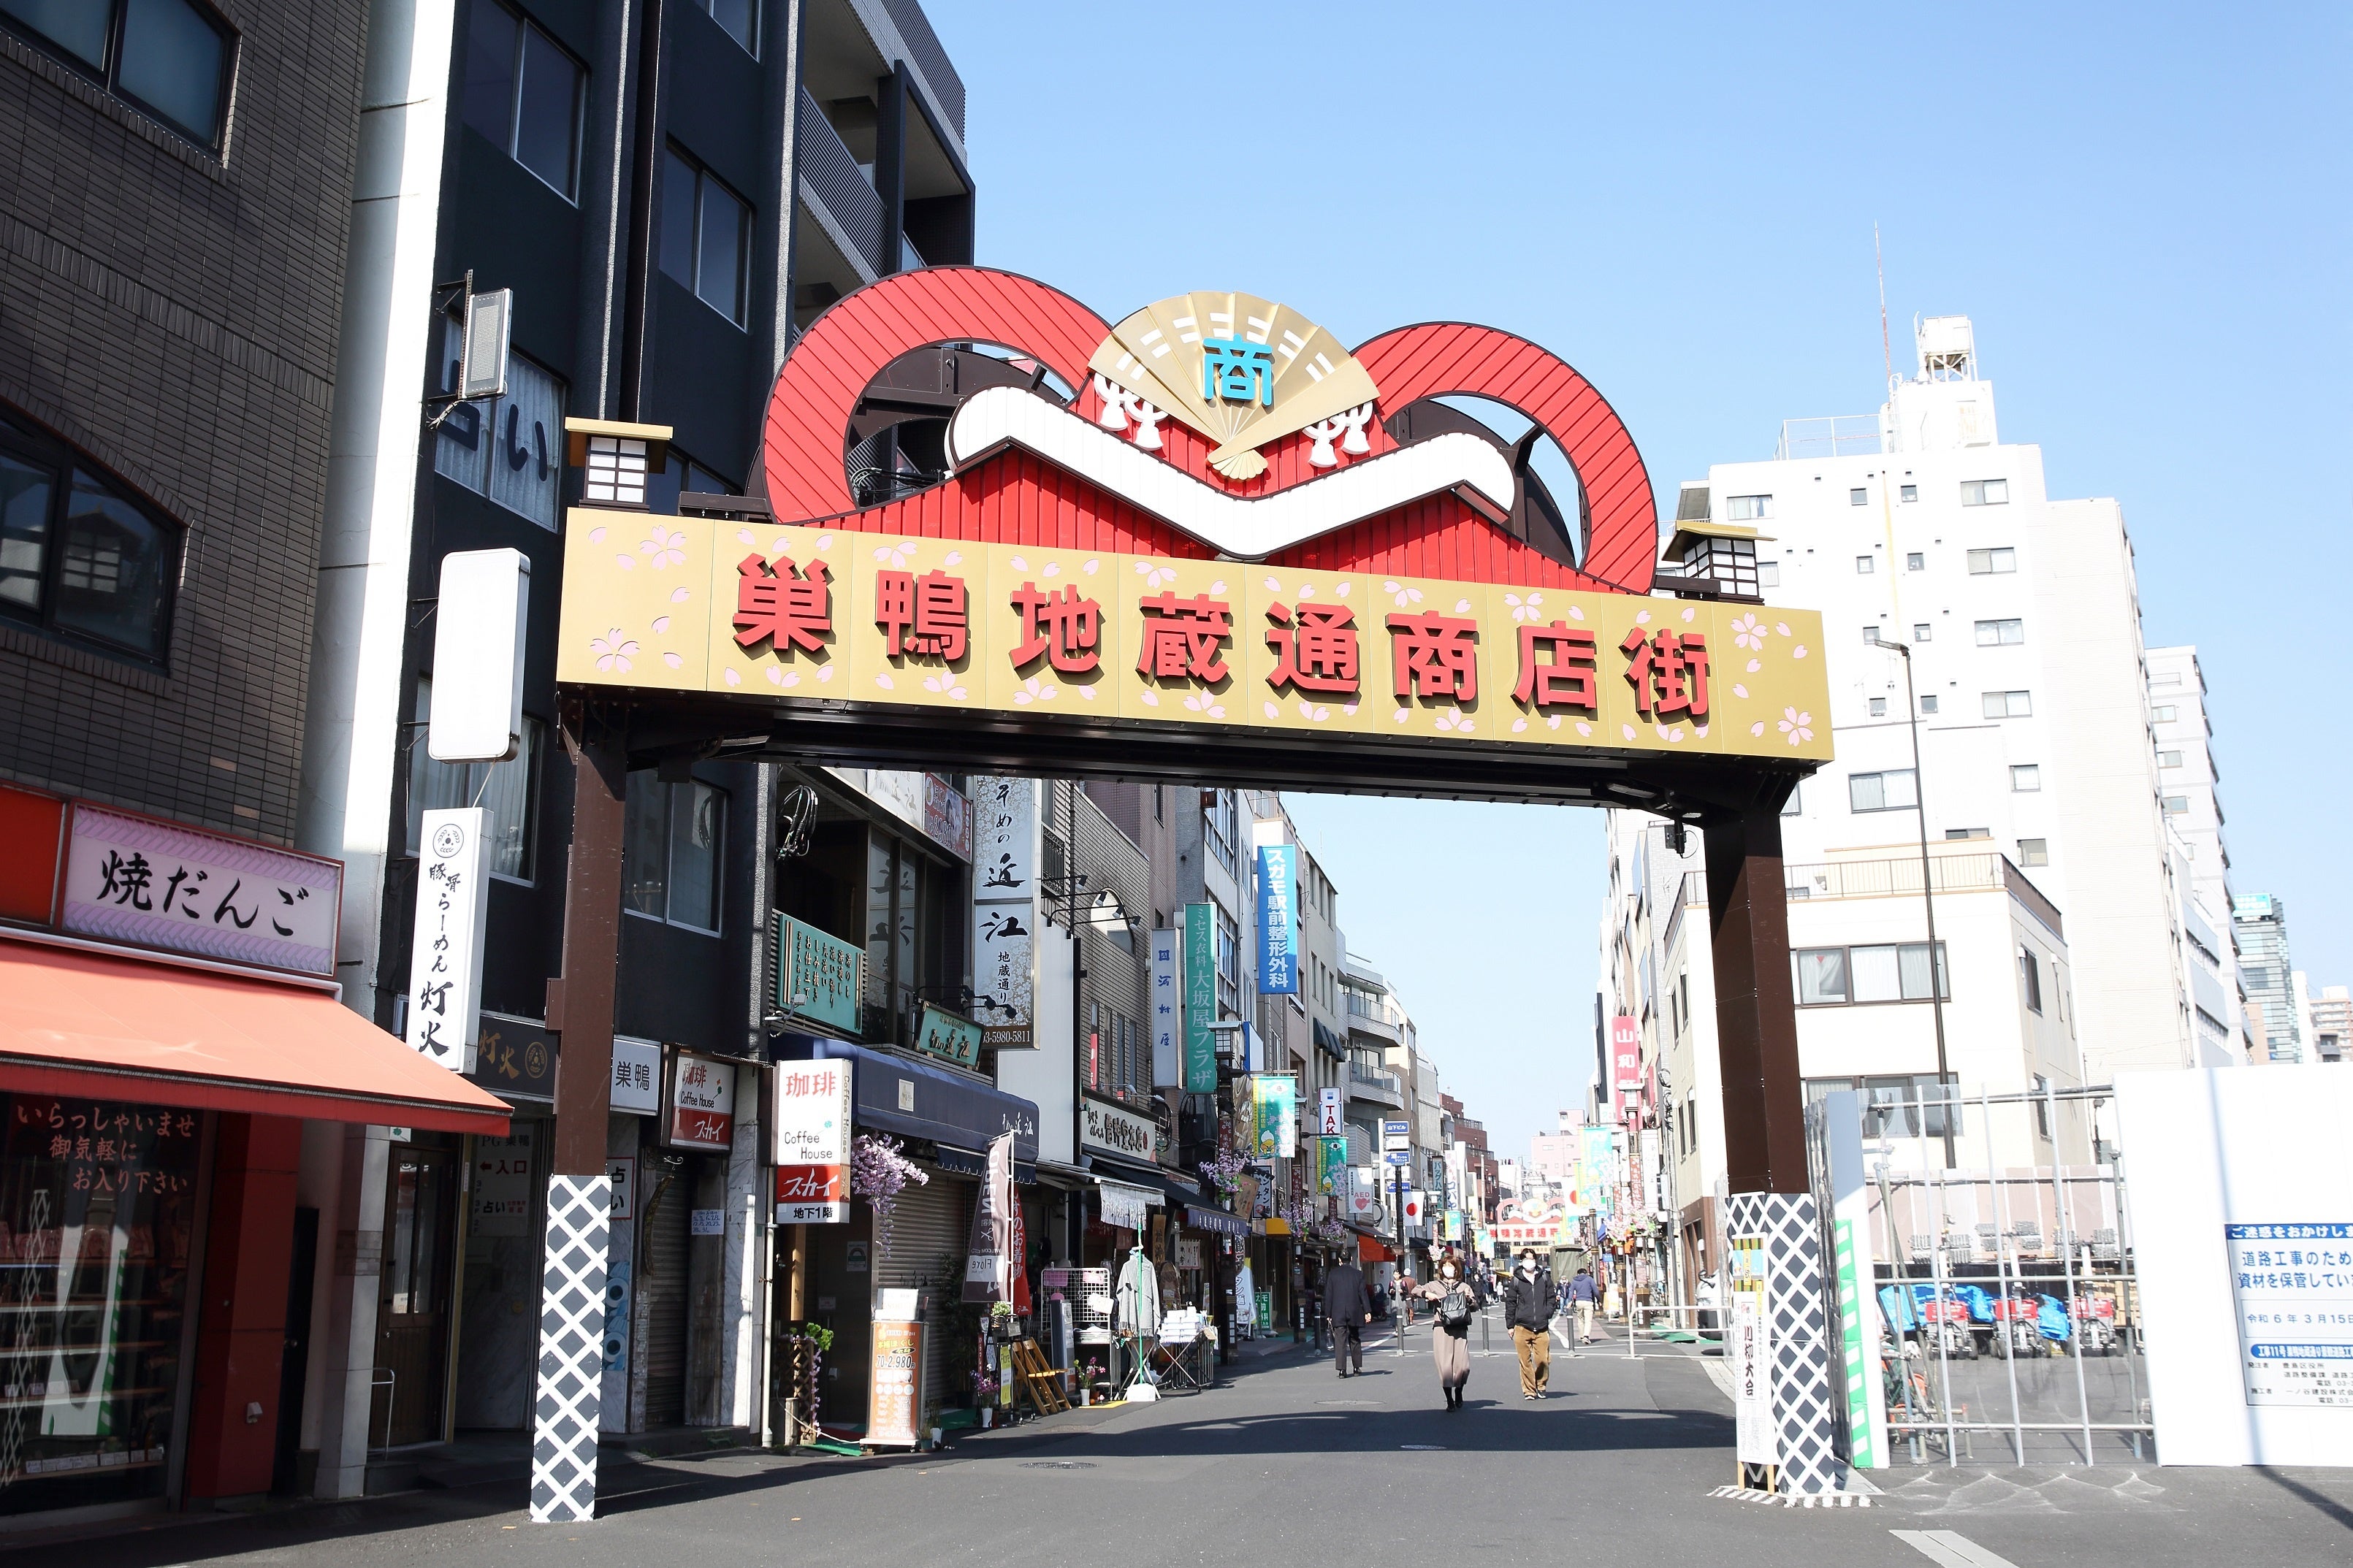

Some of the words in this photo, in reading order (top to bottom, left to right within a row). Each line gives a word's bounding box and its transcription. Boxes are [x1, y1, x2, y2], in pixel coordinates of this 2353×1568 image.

[1202, 334, 1273, 407] 商
[732, 553, 1712, 718] 巣鴨地蔵通商店街
[97, 849, 310, 937] 焼だんご
[1267, 849, 1289, 989] スガモ駅前整形外科
[1194, 907, 1208, 968] ミセス衣料
[997, 951, 1011, 1004] 地蔵通り
[419, 981, 454, 1056] 灯火
[1192, 969, 1213, 1089] 大坂屋プラザ
[478, 1028, 521, 1081] 灯火
[616, 1060, 650, 1091] 巣鴨
[682, 1063, 707, 1088] 珈琲
[785, 1071, 837, 1098] 珈琲
[680, 1090, 698, 1106] Coffee
[698, 1095, 715, 1109] House
[17, 1103, 196, 1138] いらっしゃいませ
[694, 1114, 724, 1141] スカイ
[50, 1135, 138, 1161] 御気軽に
[784, 1131, 820, 1144] Coffee
[842, 1118, 850, 1154] House
[496, 1160, 527, 1174] 入口
[801, 1147, 833, 1160] House
[73, 1167, 188, 1196] お入り下さい
[781, 1167, 839, 1198] スカイ
[483, 1201, 506, 1213] 占い
[793, 1206, 834, 1219] 地下1階
[2242, 1251, 2352, 1266] 道路工事のため
[2238, 1272, 2353, 1288] 資材を保管してい
